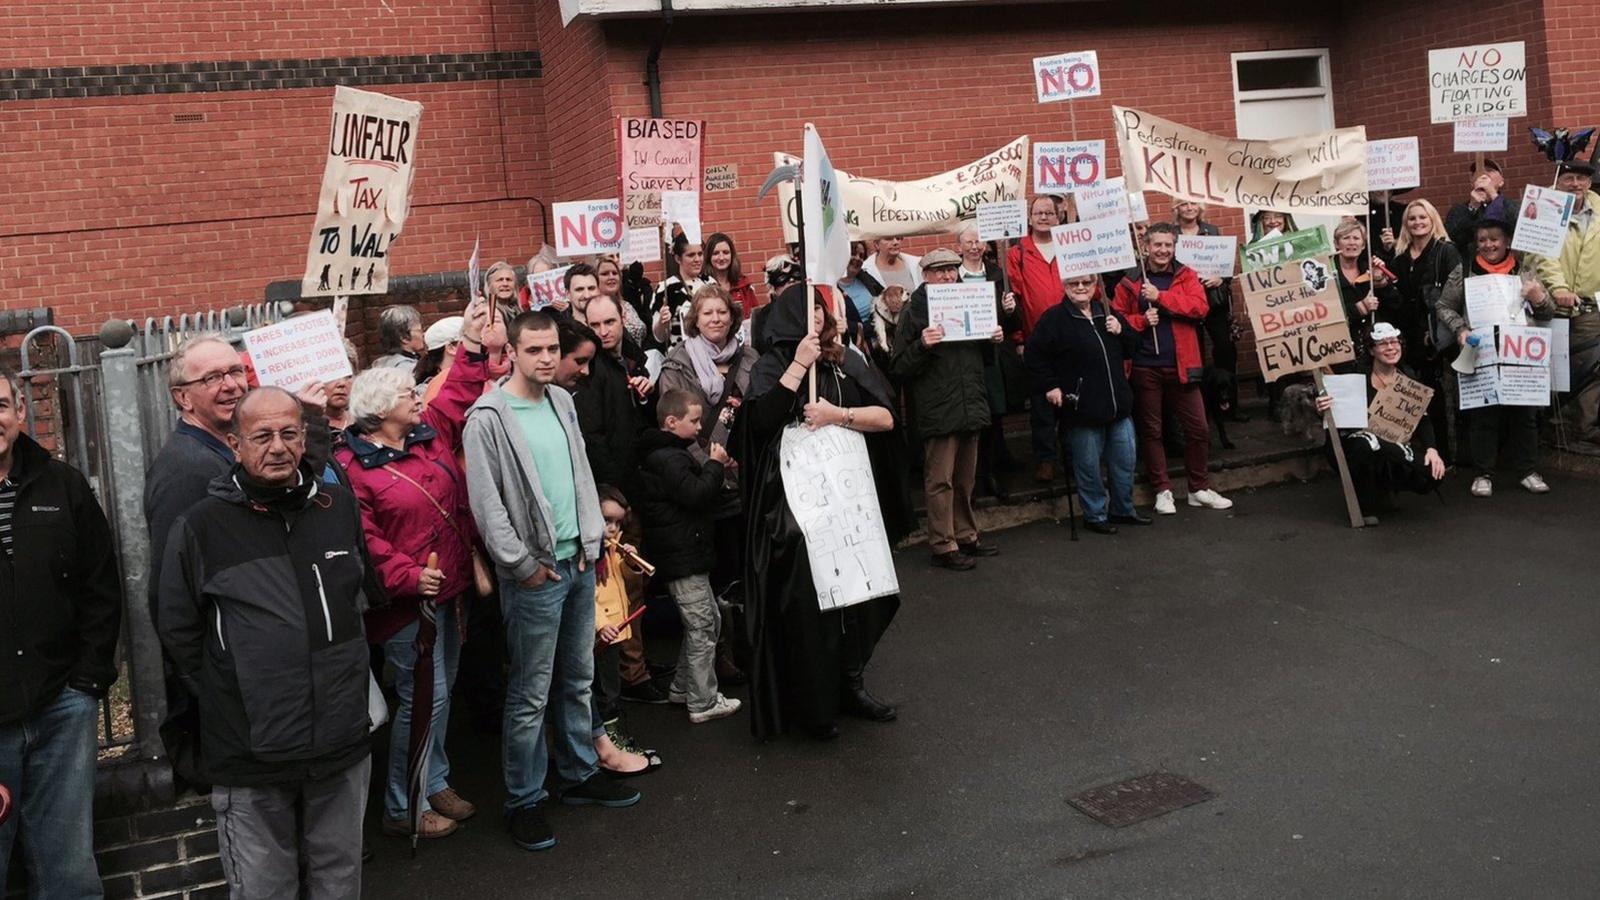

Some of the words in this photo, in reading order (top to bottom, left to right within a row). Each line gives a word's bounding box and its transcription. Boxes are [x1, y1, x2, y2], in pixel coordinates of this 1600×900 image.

[1458, 48, 1501, 68] NO
[1041, 63, 1094, 96] NO
[1432, 69, 1499, 88] CHARGES
[1503, 67, 1525, 81] ON
[1441, 85, 1513, 104] FLOATING
[1453, 99, 1518, 116] BRIDGE
[331, 112, 410, 164] UNFAIR
[627, 119, 698, 139] BIASED
[1122, 110, 1207, 156] Pedestrian
[1227, 149, 1292, 175] charges
[655, 150, 692, 166] Council
[705, 165, 728, 174] ONLY
[1040, 153, 1100, 186] NO
[1368, 156, 1386, 164] OSTS
[1143, 147, 1225, 200] KILL
[349, 177, 382, 209] TAX
[1233, 175, 1278, 208] local
[1289, 181, 1369, 208] businesses
[587, 204, 608, 212] fares
[873, 196, 951, 222] PEDESTRIANS
[319, 227, 340, 254] TO
[560, 211, 623, 248] NO
[1056, 228, 1092, 246] WHO
[1096, 232, 1114, 240] pays
[1062, 248, 1097, 260] Yarmouth
[1181, 239, 1204, 249] WHO
[1064, 260, 1101, 272] COUNCIL
[1104, 257, 1120, 267] TAX
[1247, 266, 1287, 292] IWC
[1266, 291, 1295, 308] Suck
[1299, 286, 1316, 298] the
[249, 329, 283, 345] FARES
[294, 316, 331, 333] FOOTIES
[1260, 302, 1328, 333] BLOOD
[263, 338, 309, 359] INCREASE
[309, 331, 336, 345] COSTS
[1503, 334, 1547, 361] NO
[268, 354, 312, 374] REVENUE
[315, 346, 341, 359] DOWN
[1396, 398, 1422, 417] IWC
